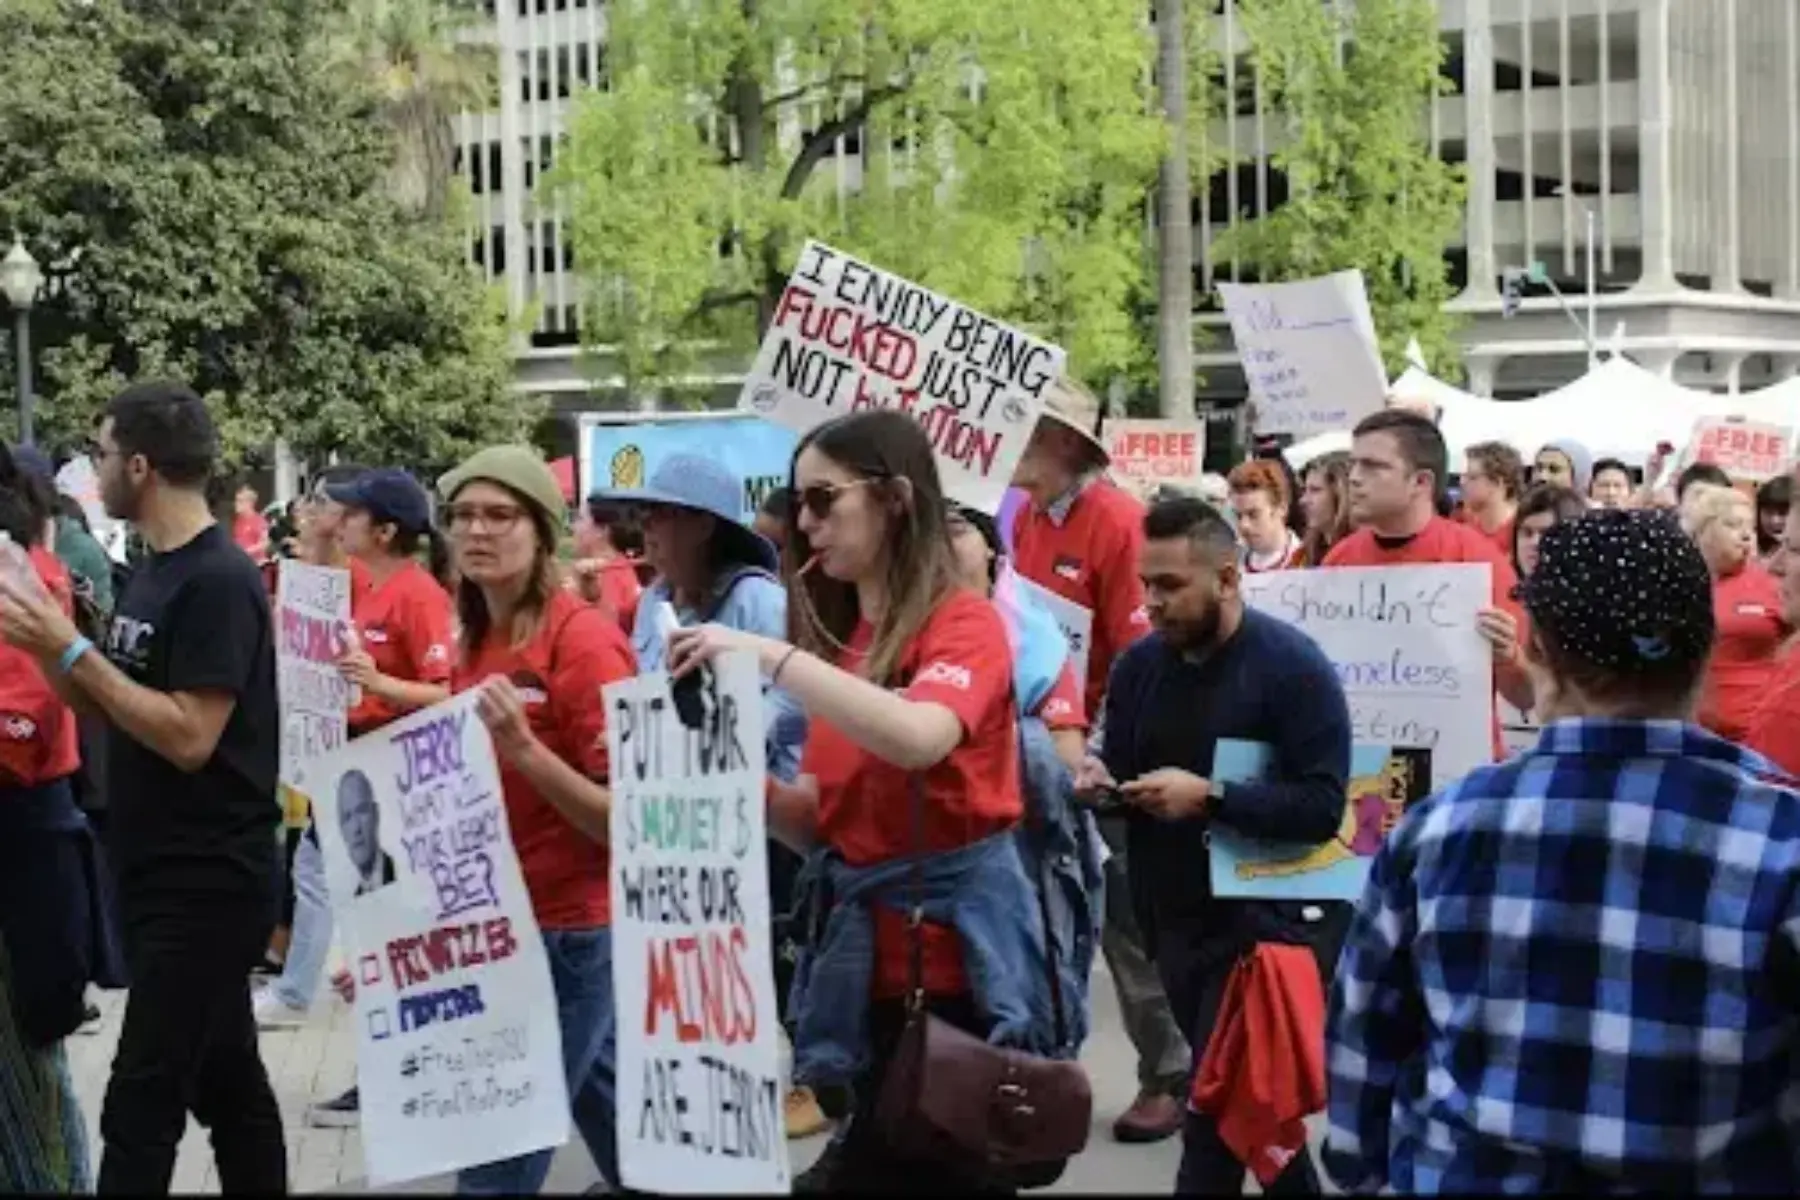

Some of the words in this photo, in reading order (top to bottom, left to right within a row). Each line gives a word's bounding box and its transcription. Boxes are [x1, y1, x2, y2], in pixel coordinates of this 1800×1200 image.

[775, 286, 918, 381] FUCKED
[914, 351, 1006, 420] JUST
[799, 246, 837, 287] I
[836, 261, 950, 334] ENJOY
[944, 309, 1053, 398] BEING
[771, 339, 854, 406] NOT
[1280, 581, 1459, 627] Shouldn't
[1333, 648, 1461, 692] meless
[390, 707, 468, 793] JERRY
[615, 697, 665, 781] PUT
[621, 866, 692, 924] WHERE
[698, 866, 748, 925] OUR
[643, 926, 757, 1046] MINDS
